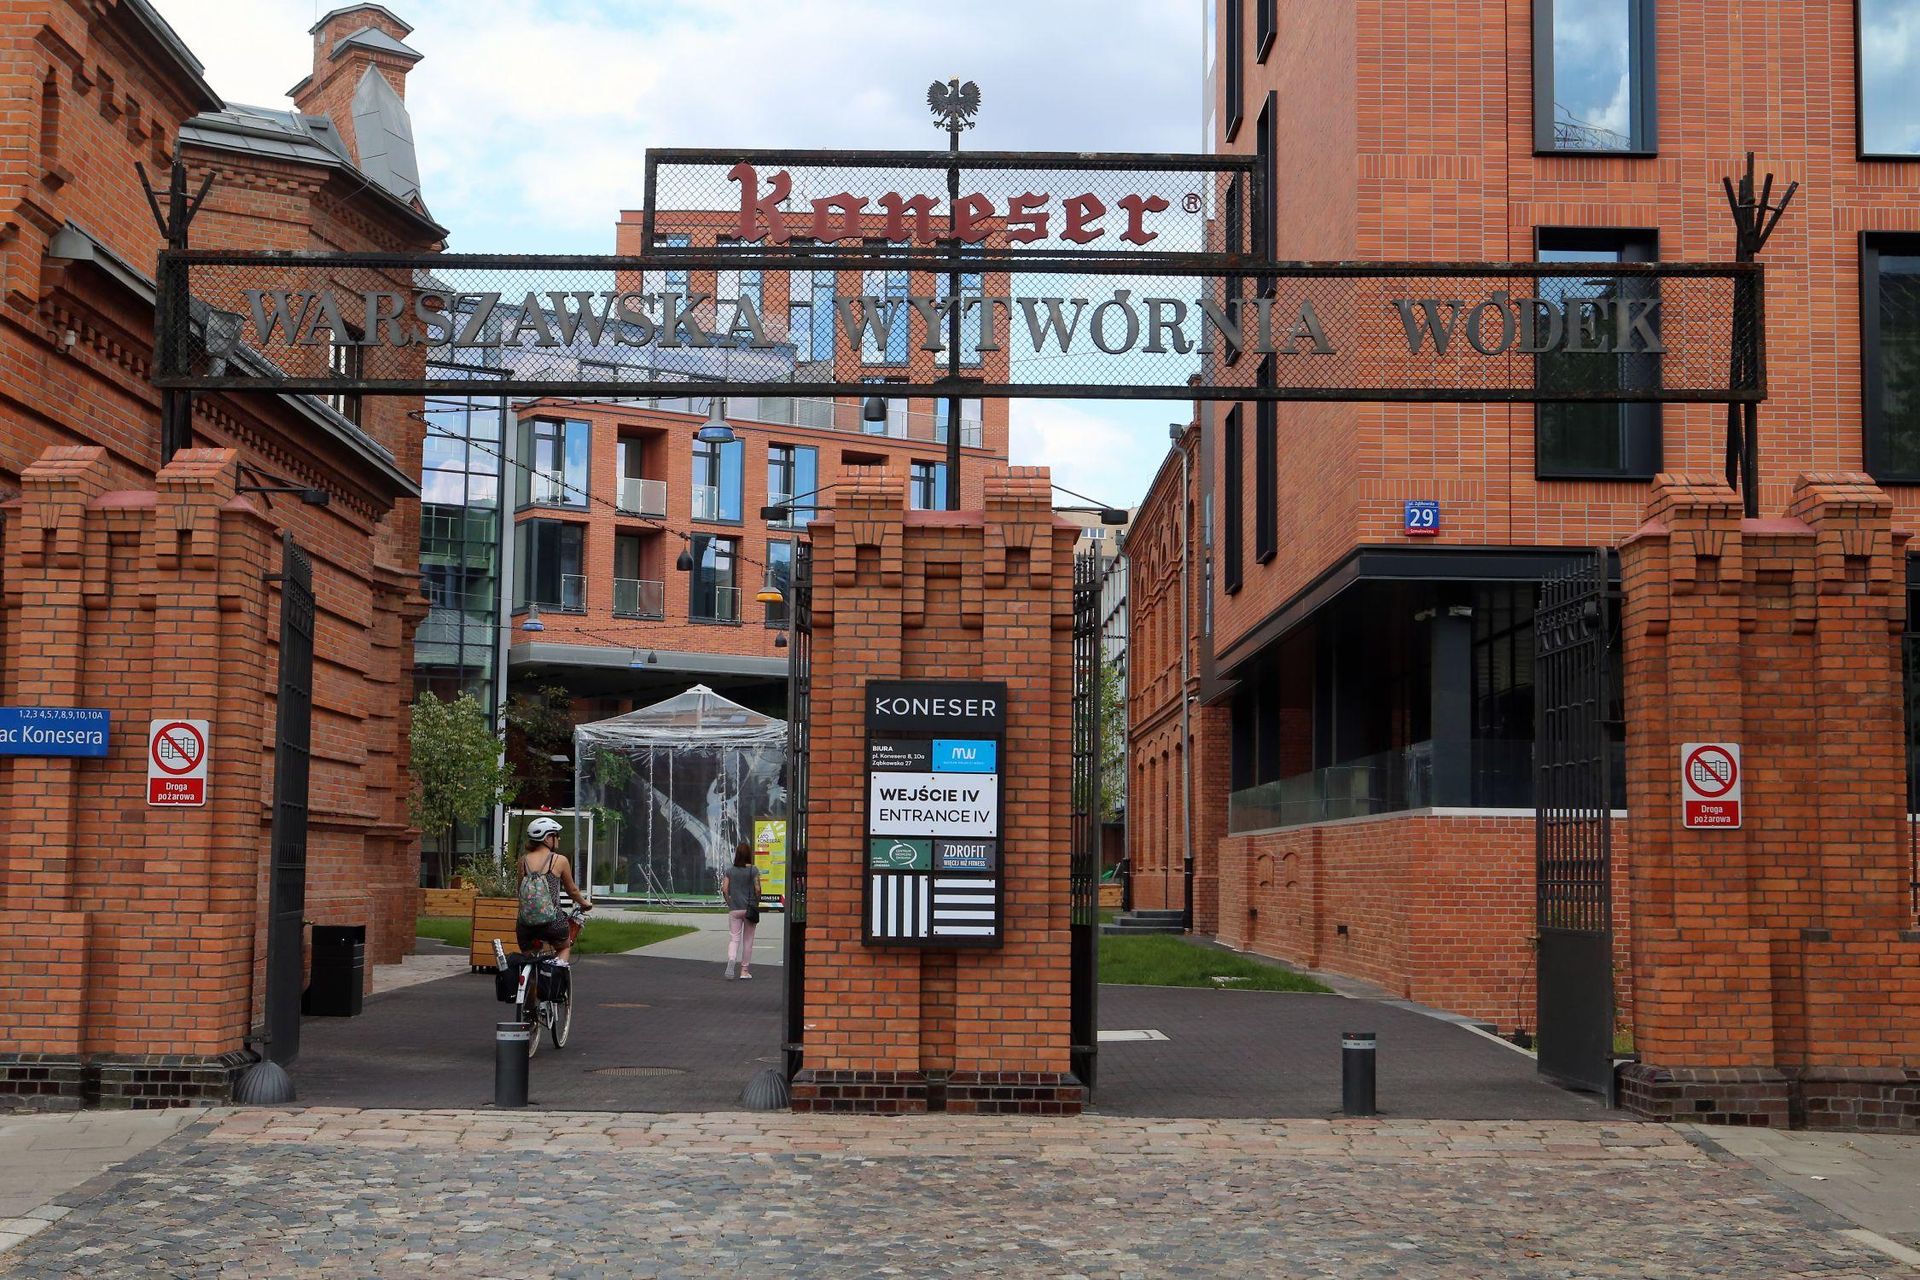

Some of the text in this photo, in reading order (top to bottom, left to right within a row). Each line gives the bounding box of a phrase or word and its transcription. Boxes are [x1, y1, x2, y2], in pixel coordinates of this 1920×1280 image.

[727, 161, 1169, 245] Koneser
[242, 289, 1667, 356] WARSZAWSKA WYTWÓRNIA WÓDEK
[1410, 508, 1434, 527] 29
[875, 697, 996, 717] KONESER
[22, 725, 103, 745] Konesera
[165, 781, 188, 793] Droga
[879, 785, 980, 803] WEJŚCIE IV
[157, 791, 195, 802] pożarowa
[879, 808, 990, 823] ENTRANCE IV
[1701, 804, 1723, 814] Droga
[1694, 814, 1731, 824] pożarowa
[943, 844, 986, 858] ZDROFIT
